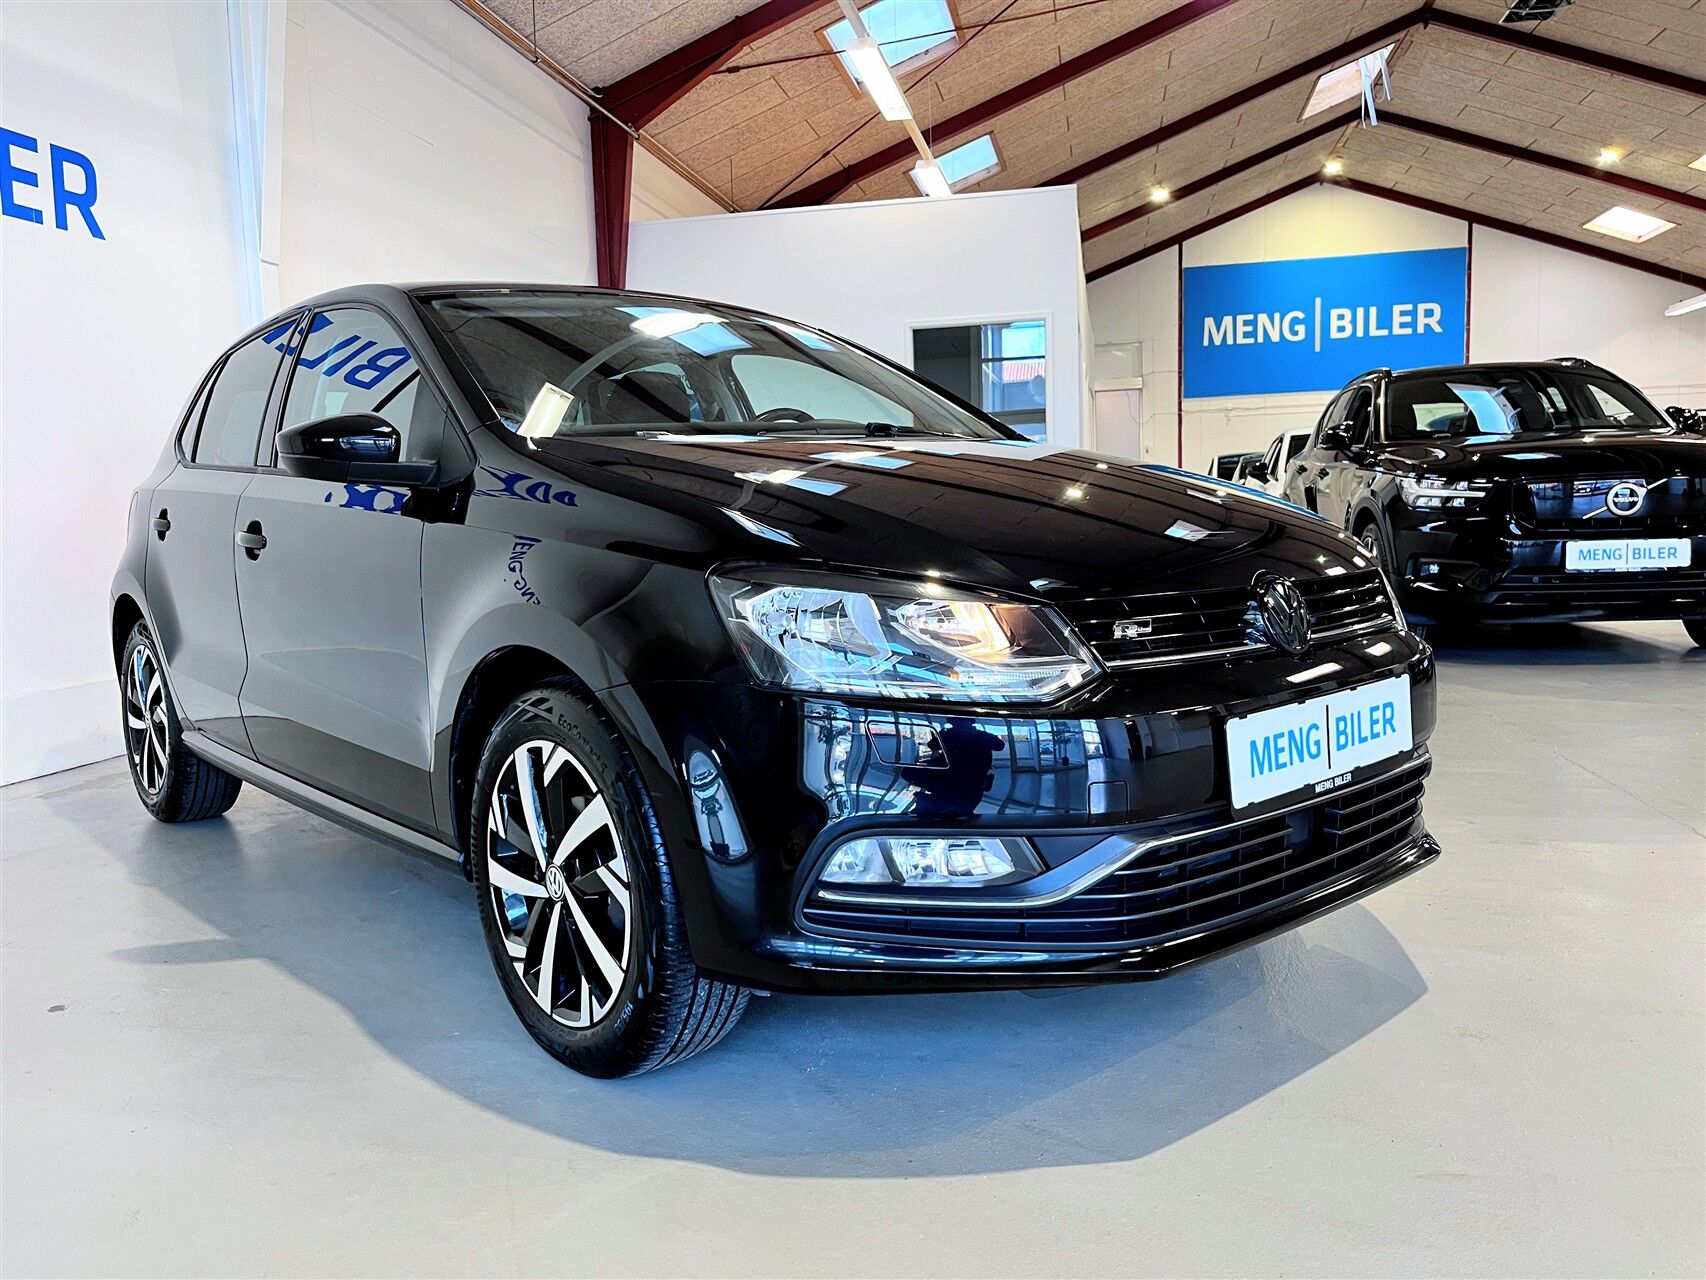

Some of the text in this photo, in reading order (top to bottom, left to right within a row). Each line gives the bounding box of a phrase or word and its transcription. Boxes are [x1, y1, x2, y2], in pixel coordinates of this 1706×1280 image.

[1202, 302, 1443, 347] MENG BILER
[1578, 546, 1678, 561] MENG BILER
[1249, 701, 1397, 778] MENG BILER
[1315, 772, 1352, 794] MENG BILER
